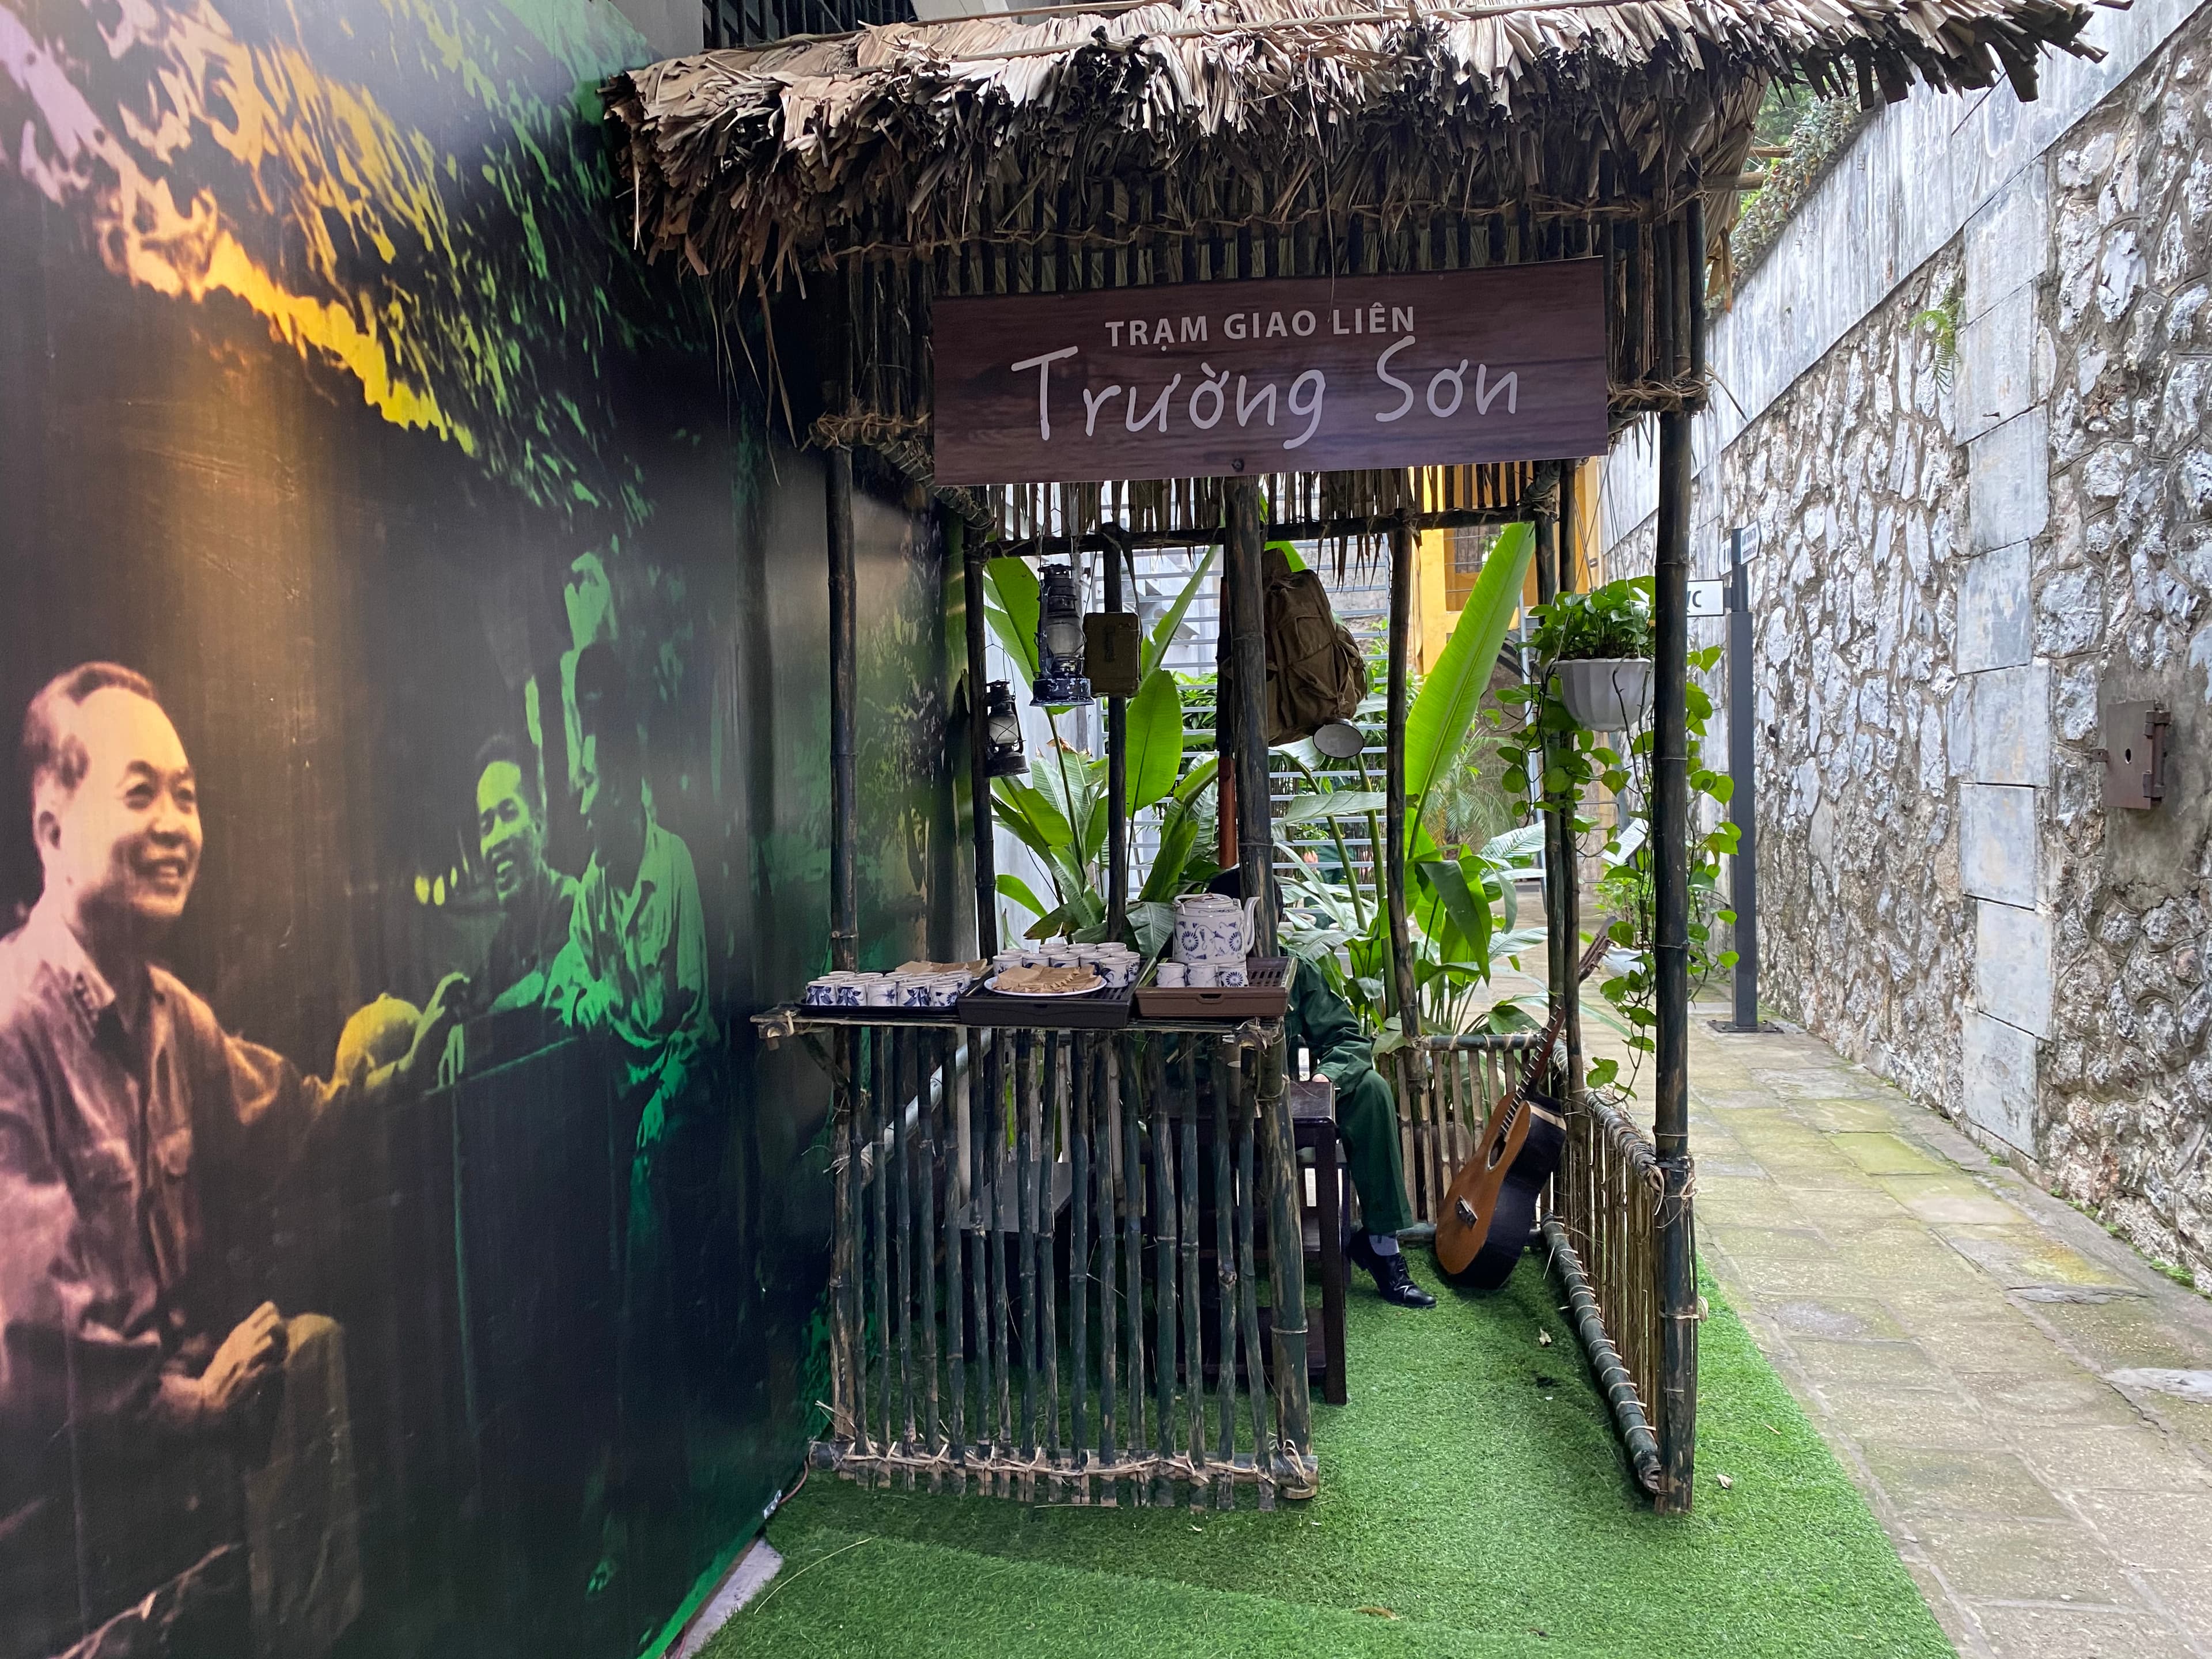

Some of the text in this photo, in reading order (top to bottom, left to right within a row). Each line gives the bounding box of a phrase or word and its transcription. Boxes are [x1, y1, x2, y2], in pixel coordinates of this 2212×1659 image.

[1104, 302, 1414, 351] TRẠM GIAO LIÊN
[1010, 335, 1518, 450] Trường Sơn
